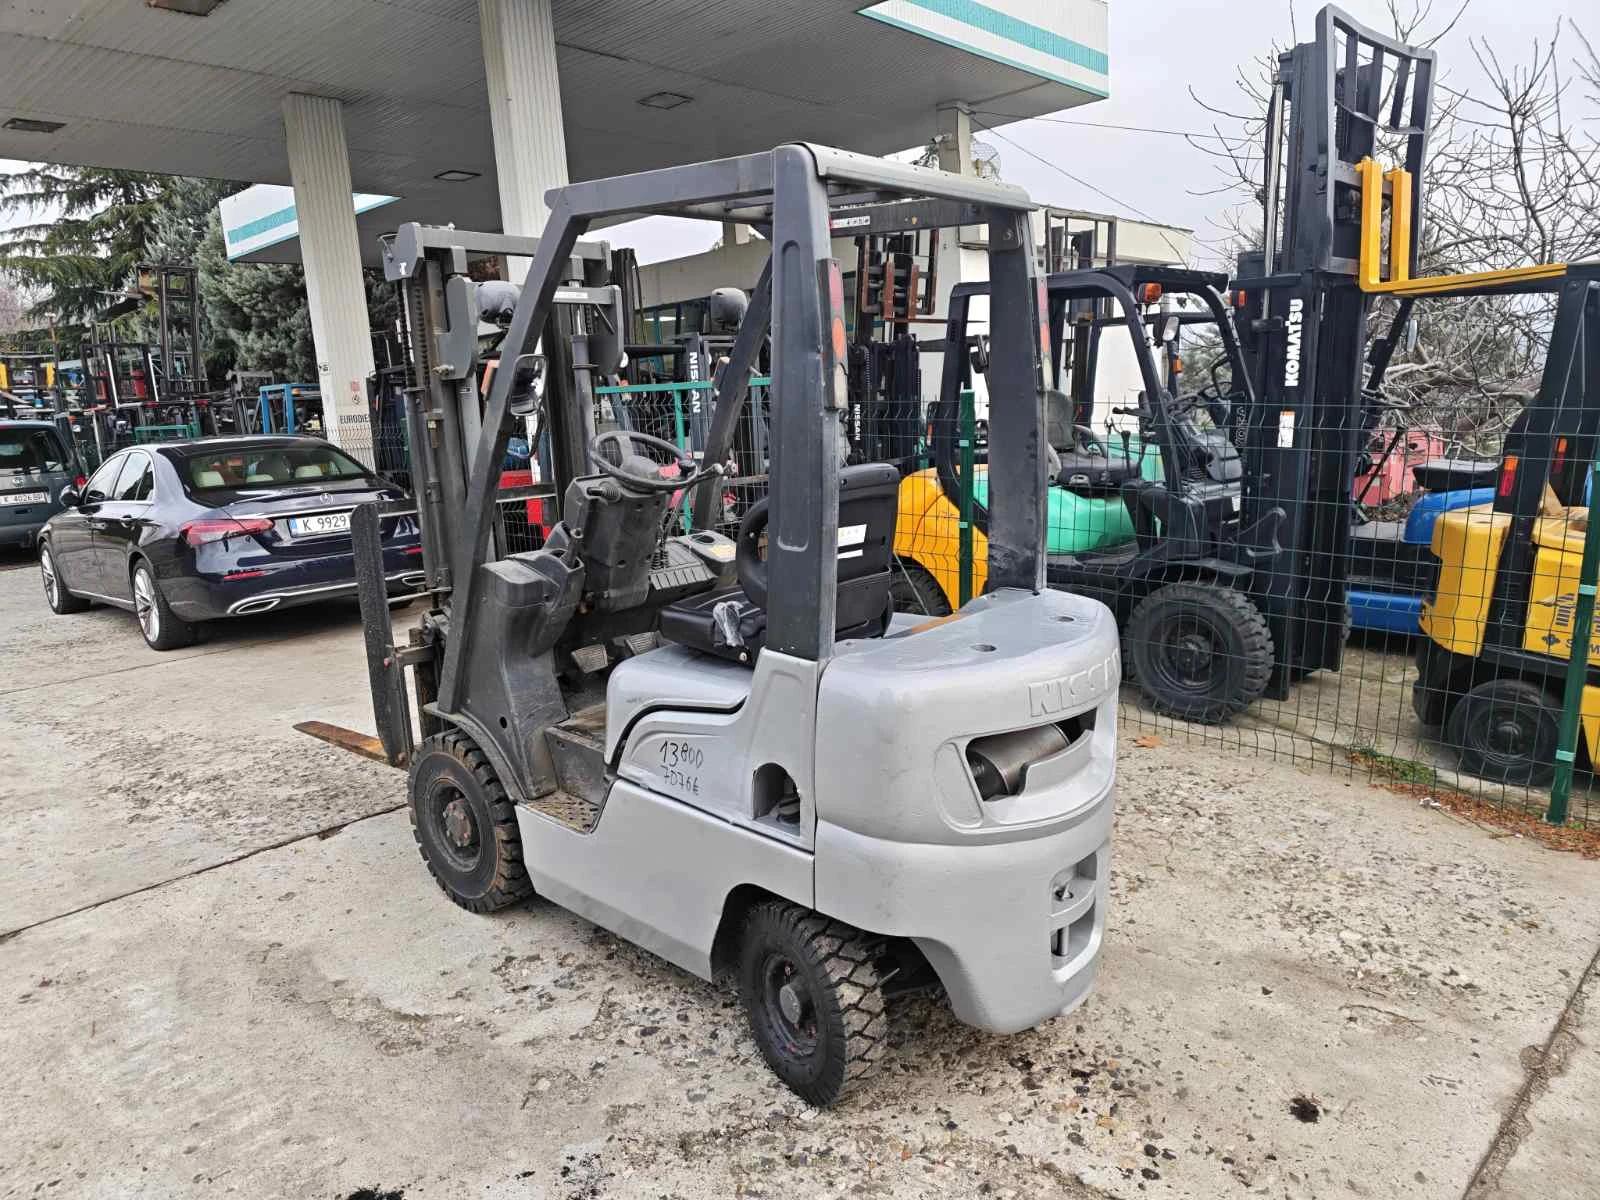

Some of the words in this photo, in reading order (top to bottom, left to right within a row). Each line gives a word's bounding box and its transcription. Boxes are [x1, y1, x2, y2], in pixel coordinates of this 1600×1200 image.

[1285, 298, 1304, 387] KOMATSU
[689, 351, 701, 413] NISAN
[302, 519, 313, 531] K
[317, 515, 347, 529] 9929
[659, 740, 704, 768] 13800
